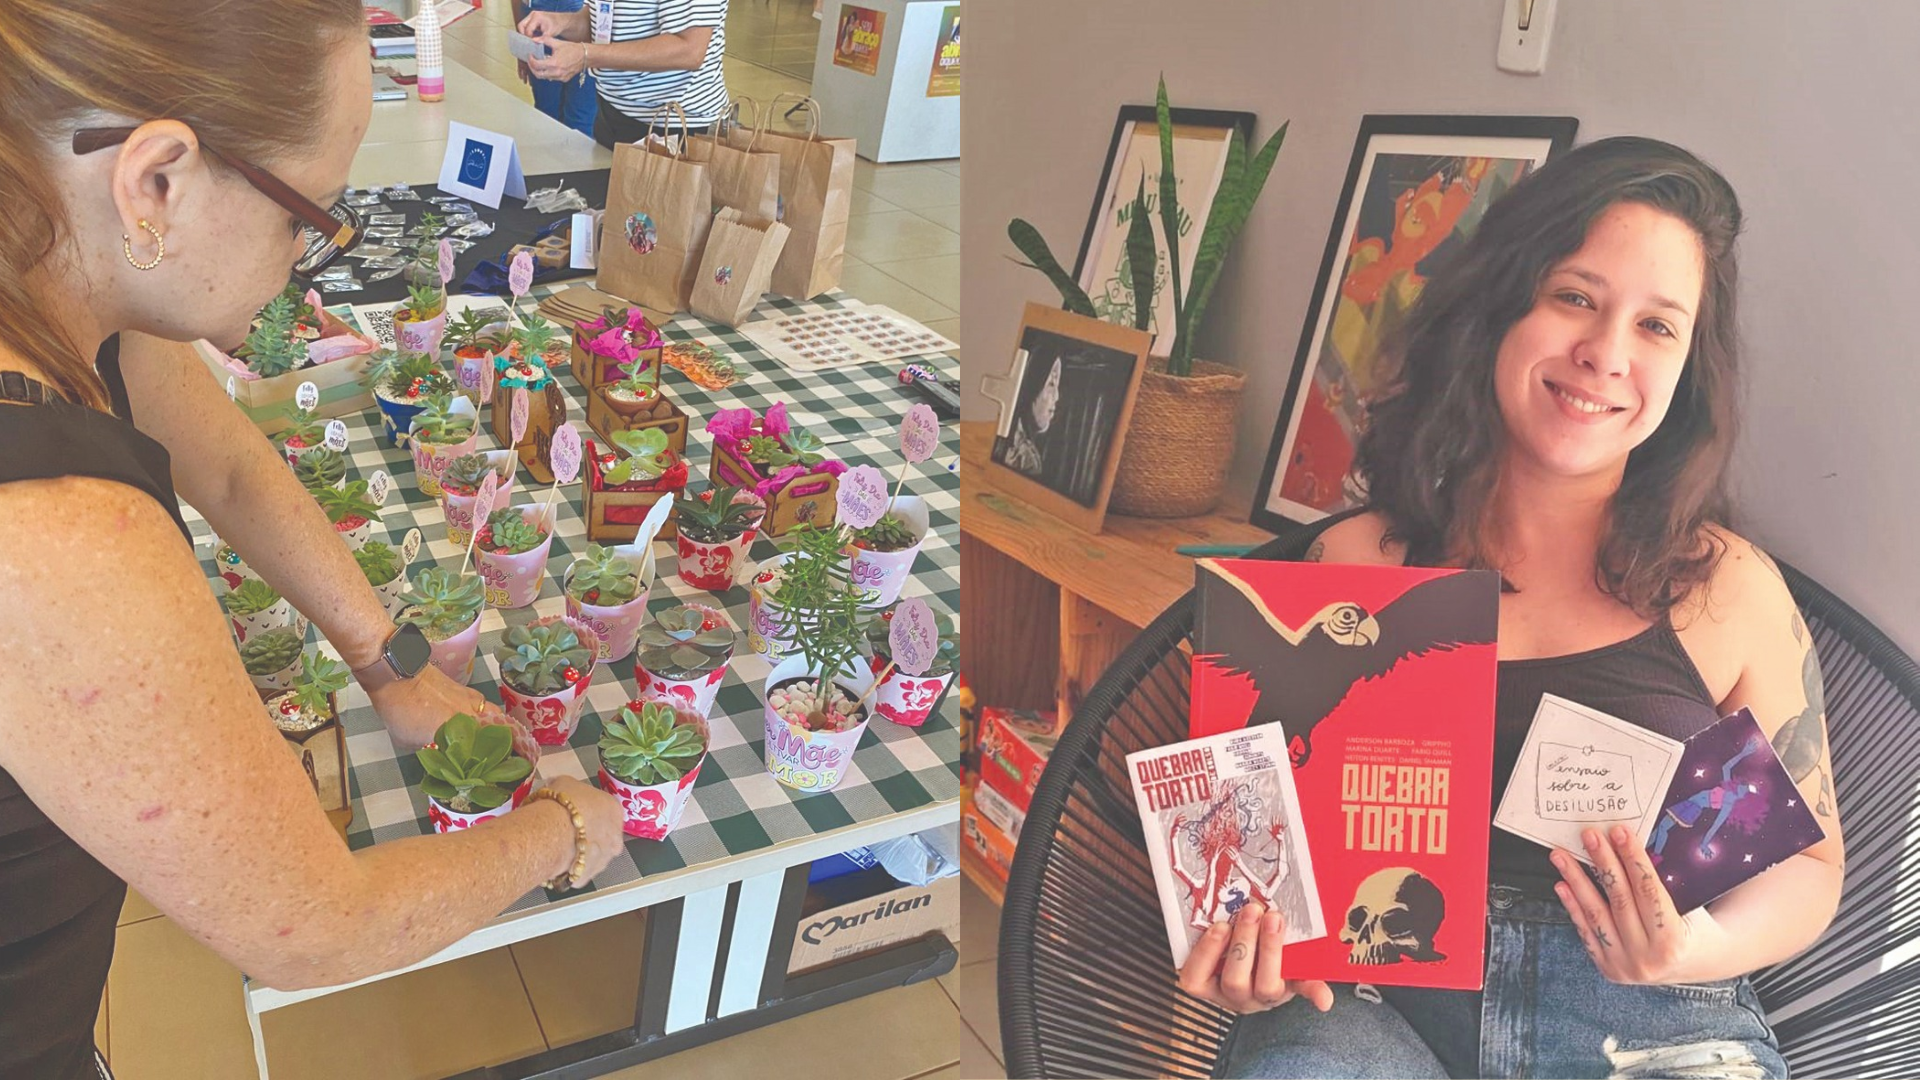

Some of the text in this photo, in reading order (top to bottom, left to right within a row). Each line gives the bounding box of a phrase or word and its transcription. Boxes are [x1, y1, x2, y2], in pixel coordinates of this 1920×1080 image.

[777, 728, 843, 770] Mãe
[1136, 748, 1204, 785] QUEBRA
[768, 754, 838, 788] MOR
[1342, 763, 1449, 805] QUEBRA
[1546, 778, 1623, 793] sobre a
[1141, 773, 1211, 813] TORTO
[1546, 795, 1628, 813] DESILUSÃO
[1341, 804, 1448, 854] TORTO
[801, 894, 932, 945] Marilan
